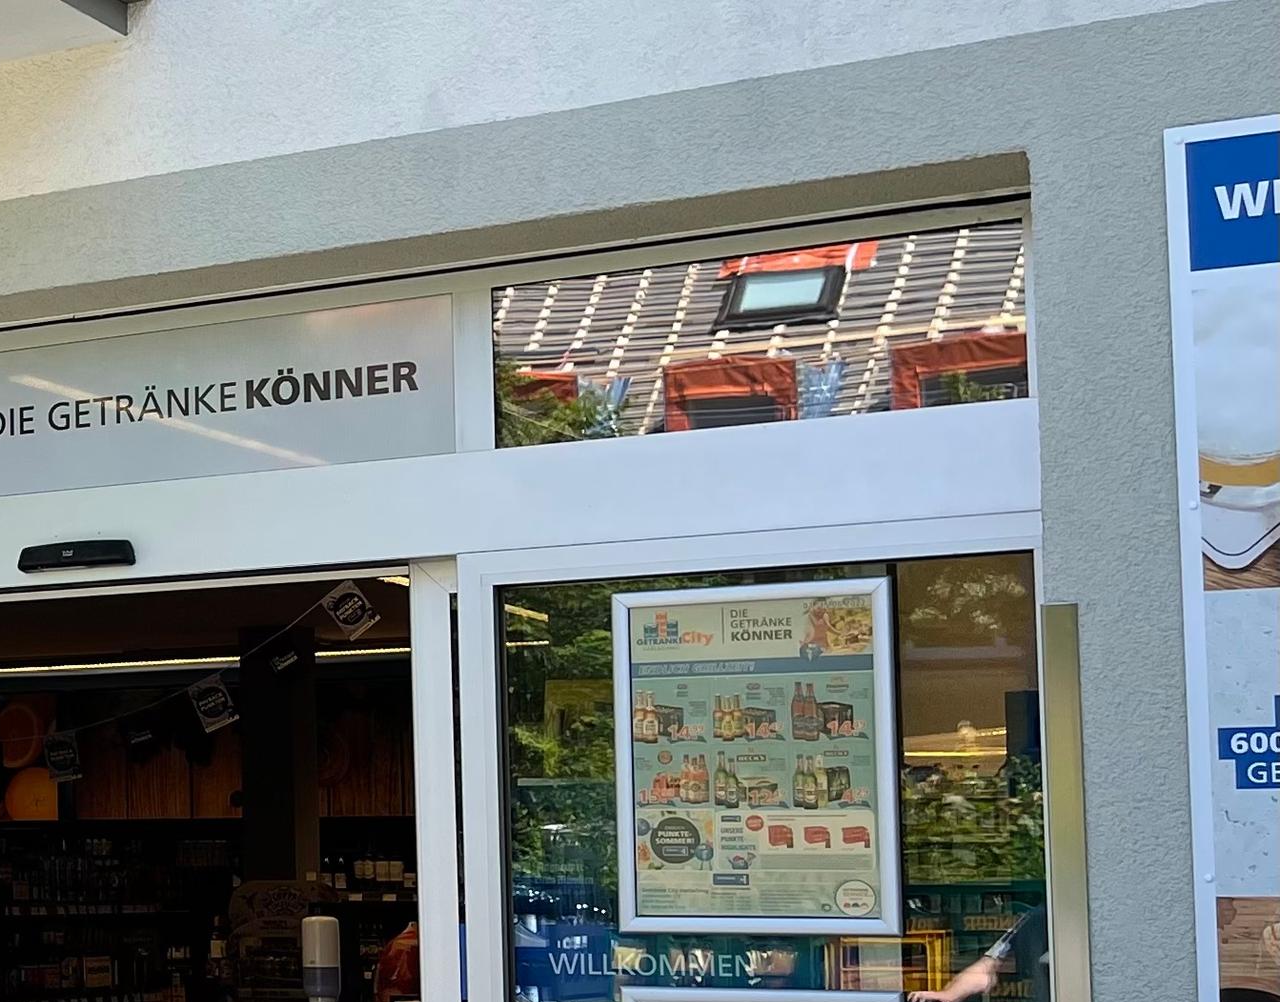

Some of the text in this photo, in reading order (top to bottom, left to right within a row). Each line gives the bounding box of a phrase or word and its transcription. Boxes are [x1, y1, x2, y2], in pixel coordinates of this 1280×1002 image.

[46, 380, 239, 433] GETRÄNKE
[245, 359, 419, 410] KÖNNER
[730, 609, 749, 619] DIE
[730, 616, 793, 629] GETRÄNKE
[680, 630, 715, 647] City
[730, 628, 793, 642] KÖNNER
[548, 951, 756, 978] WILLKOMMEN
